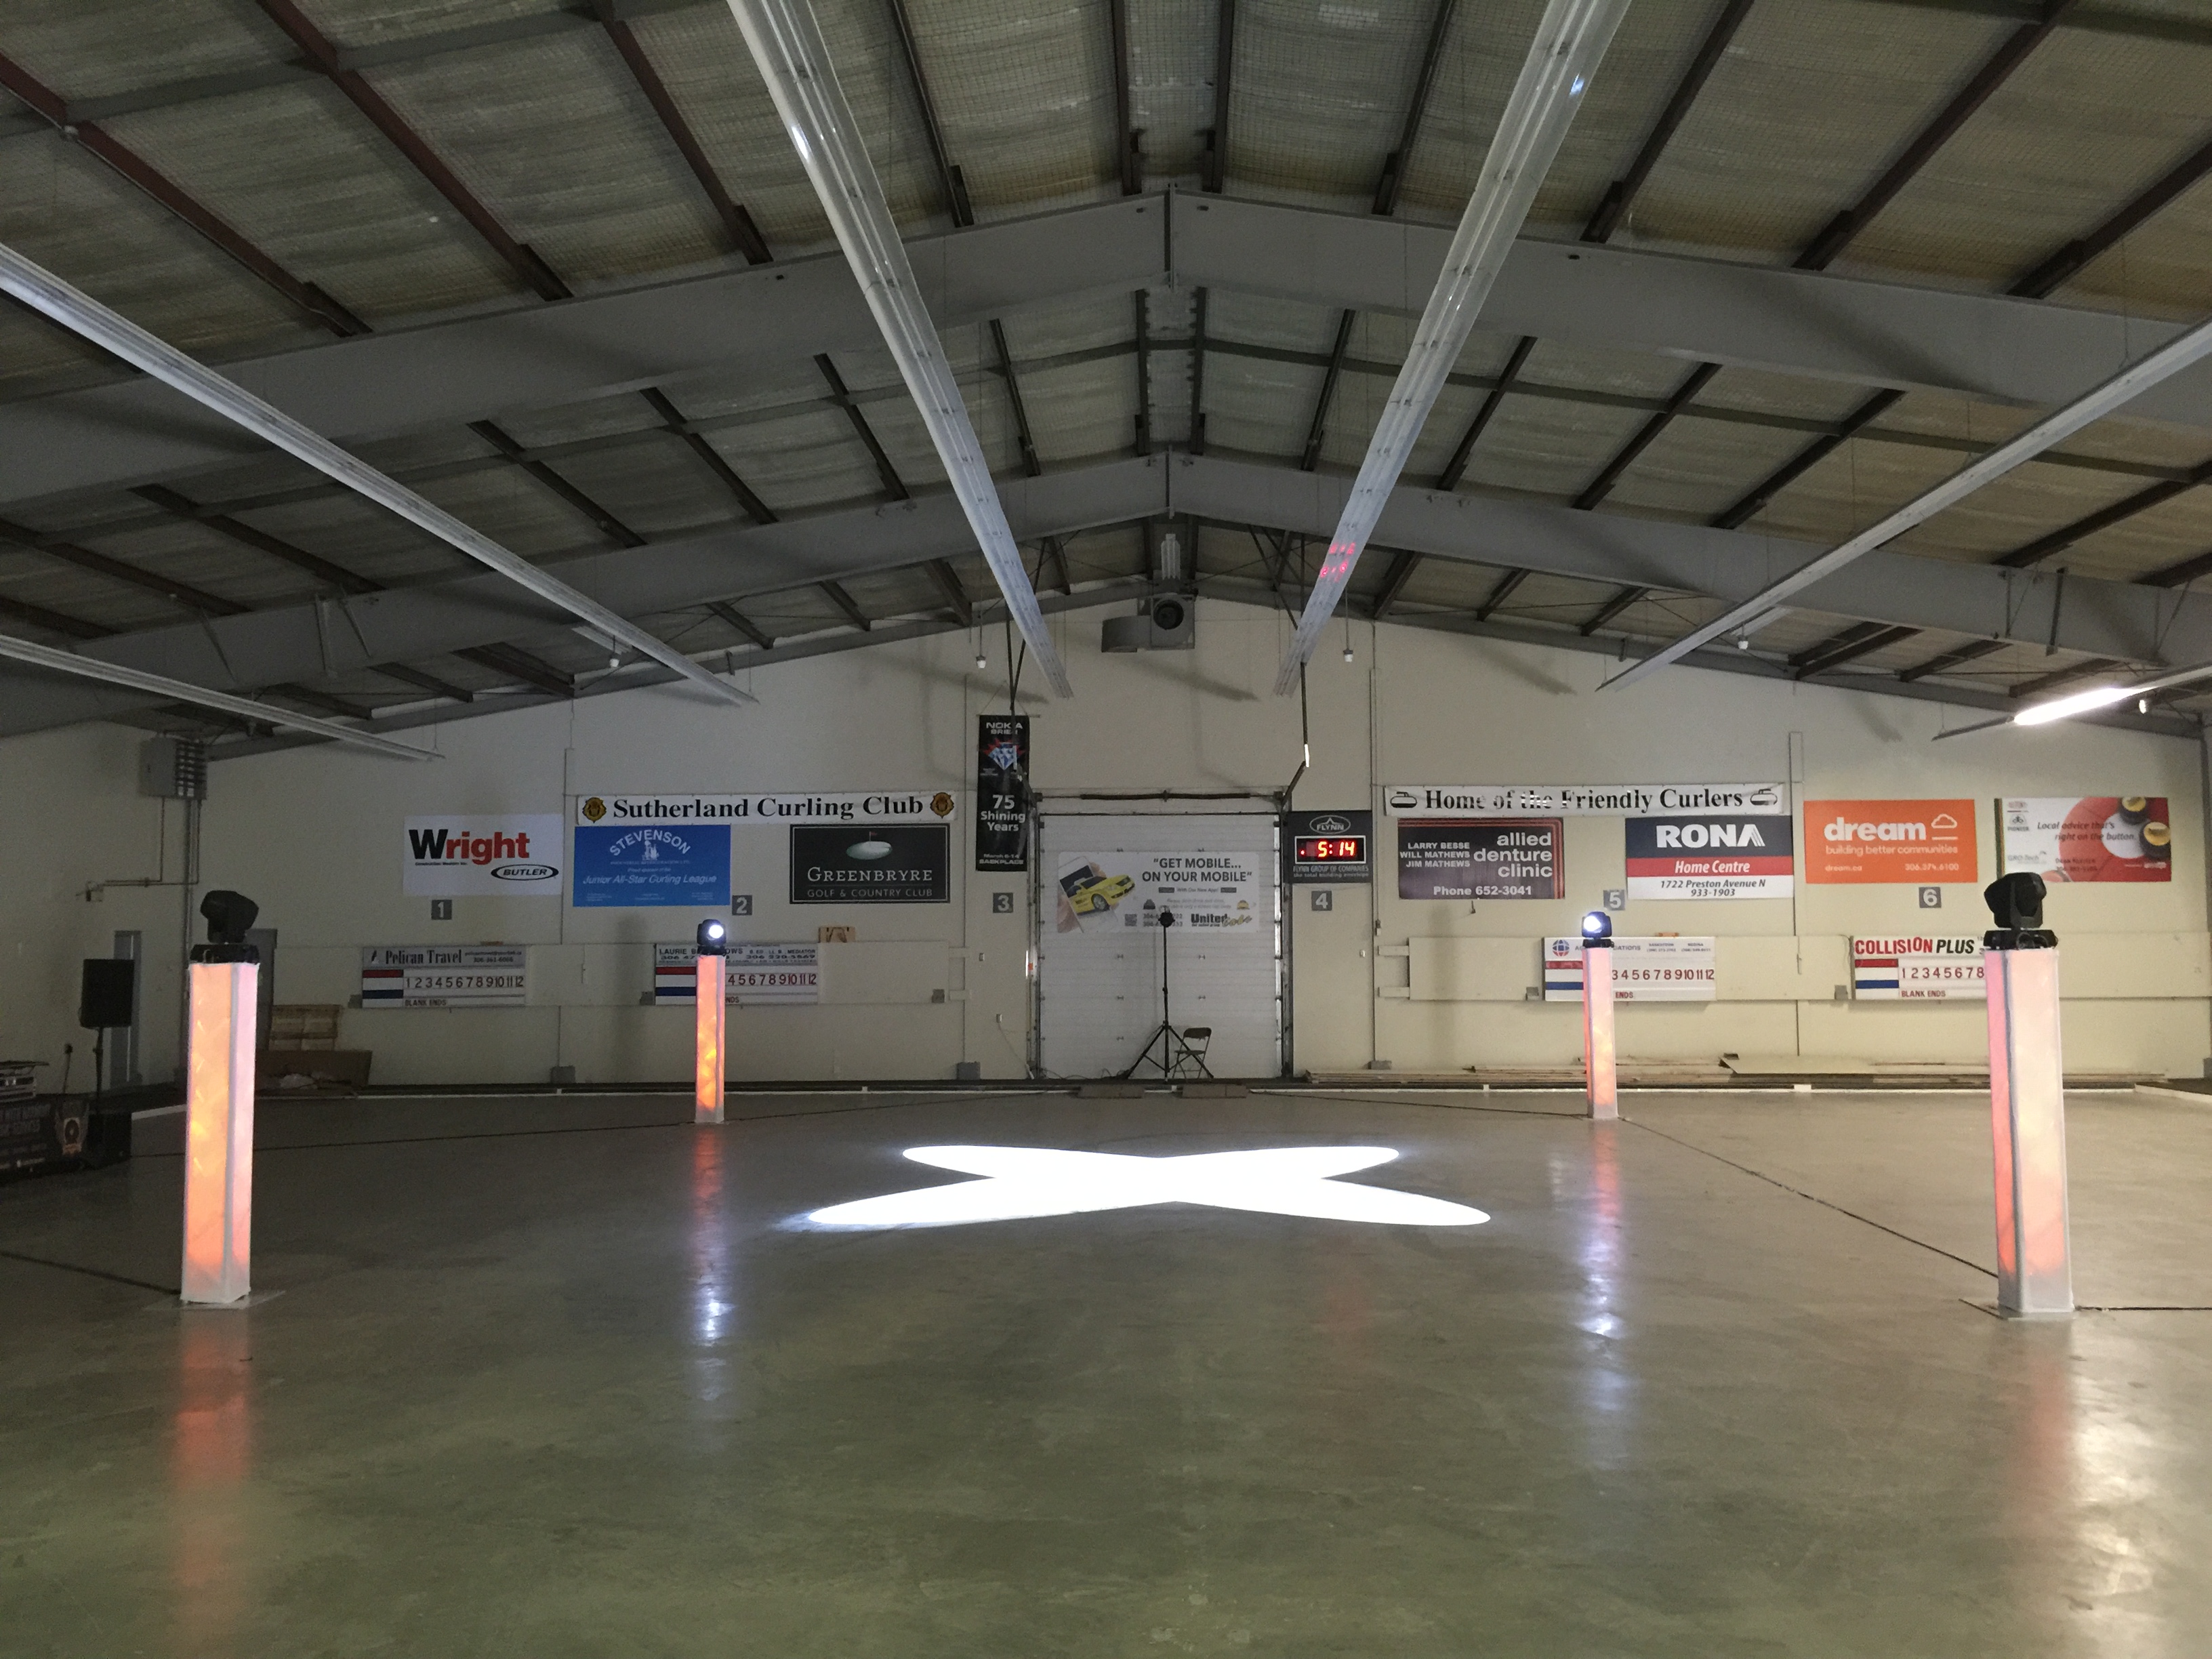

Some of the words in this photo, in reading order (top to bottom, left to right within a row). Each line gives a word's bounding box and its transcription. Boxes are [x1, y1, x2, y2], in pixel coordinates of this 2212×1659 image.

[986, 722, 1023, 730] NOKA
[992, 794, 1015, 810] 75
[1425, 790, 1487, 809] Home
[1493, 790, 1515, 809] of
[1520, 790, 1553, 809] the
[1561, 789, 1653, 813] Friendly
[1660, 788, 1744, 808] Curlers
[613, 798, 749, 818] Sutherland
[757, 797, 855, 820] Curling
[863, 796, 923, 815] Club
[981, 811, 1026, 824] Shining
[987, 822, 1019, 832] Years
[1824, 817, 1927, 841] dream
[2037, 821, 2059, 830] Local
[2062, 821, 2092, 830] advice
[2094, 821, 2115, 830] that's
[609, 829, 691, 857] STEVENSON
[1497, 832, 1552, 846] allied
[1656, 824, 1766, 848] RONA
[2054, 832, 2076, 842] right
[2090, 832, 2104, 840] the
[409, 828, 530, 865] Wright
[1317, 841, 1355, 857] 5:14
[1408, 842, 1438, 850] LARRY
[1826, 844, 1864, 857] building
[1865, 844, 1896, 855] better
[1897, 843, 1958, 855] communities
[1473, 848, 1553, 862] denture
[1185, 857, 1242, 869] MOBILE...
[1675, 860, 1709, 874] Home
[1712, 859, 1750, 874] Centre
[503, 868, 548, 876] BUTLER
[807, 866, 933, 882] GREENBRYRE
[1142, 872, 1161, 882] ON
[1163, 872, 1197, 882] YOUR
[1498, 863, 1553, 878] clinic
[583, 876, 611, 884] Junior
[612, 875, 647, 884] All-Star
[649, 874, 681, 885] Curling
[682, 874, 717, 885] League
[1660, 880, 1683, 888] 1722
[1685, 880, 1721, 888] Preston
[1723, 879, 1757, 888] Avenue
[1759, 879, 1766, 887] N
[807, 888, 836, 898] GOLF
[840, 889, 846, 898] &
[851, 888, 902, 898] COUNTRY
[905, 888, 933, 897] CLUB
[1433, 886, 1472, 896] Phone
[1475, 886, 1532, 895] 652-3041
[1691, 888, 1736, 897] 933-1903
[1923, 888, 1938, 906] 6
[736, 897, 747, 914] 2
[998, 895, 1010, 912] 3
[1315, 893, 1328, 909] 4
[1609, 891, 1622, 909] 5
[437, 901, 444, 918] 1
[1191, 914, 1228, 924] United
[1854, 937, 1933, 955] COLLISION
[1936, 939, 1975, 954] PLUS
[385, 950, 424, 965] Pelican
[426, 949, 462, 964] Travel
[728, 975, 735, 985] 4
[738, 975, 746, 985] 5
[749, 975, 756, 985] 6
[759, 975, 766, 985] 7
[769, 975, 776, 985] 8
[779, 974, 786, 985] 9
[788, 974, 798, 985] 10
[800, 974, 806, 985] 11
[808, 974, 817, 985] 12
[1612, 969, 1618, 980] 3
[1621, 969, 1629, 980] 4
[1632, 969, 1639, 980] 5
[1643, 969, 1650, 980] 6
[1654, 969, 1660, 980] 7
[1664, 969, 1671, 980] 8
[1675, 969, 1682, 980] 9
[1684, 969, 1694, 980] 10
[1696, 969, 1703, 980] 11
[1705, 969, 1715, 980] 12
[1902, 968, 1906, 979] 1
[1911, 968, 1919, 979] 2
[1922, 968, 1930, 979] 3
[1933, 968, 1940, 979] 4
[1944, 967, 1952, 979] 5
[1954, 967, 1963, 979] 6
[1965, 967, 1973, 979] 7
[1976, 967, 1984, 979] 8
[407, 978, 410, 989] 1
[415, 977, 422, 988] 2
[426, 977, 433, 988] 3
[435, 977, 443, 988] 4
[446, 977, 453, 988] 5
[456, 977, 463, 988] 6
[466, 977, 473, 988] 7
[476, 977, 483, 987] 8
[486, 977, 493, 987] 9
[495, 977, 505, 987] 10
[506, 977, 513, 987] 11
[515, 977, 524, 987] 12
[405, 999, 428, 1007] BLANK
